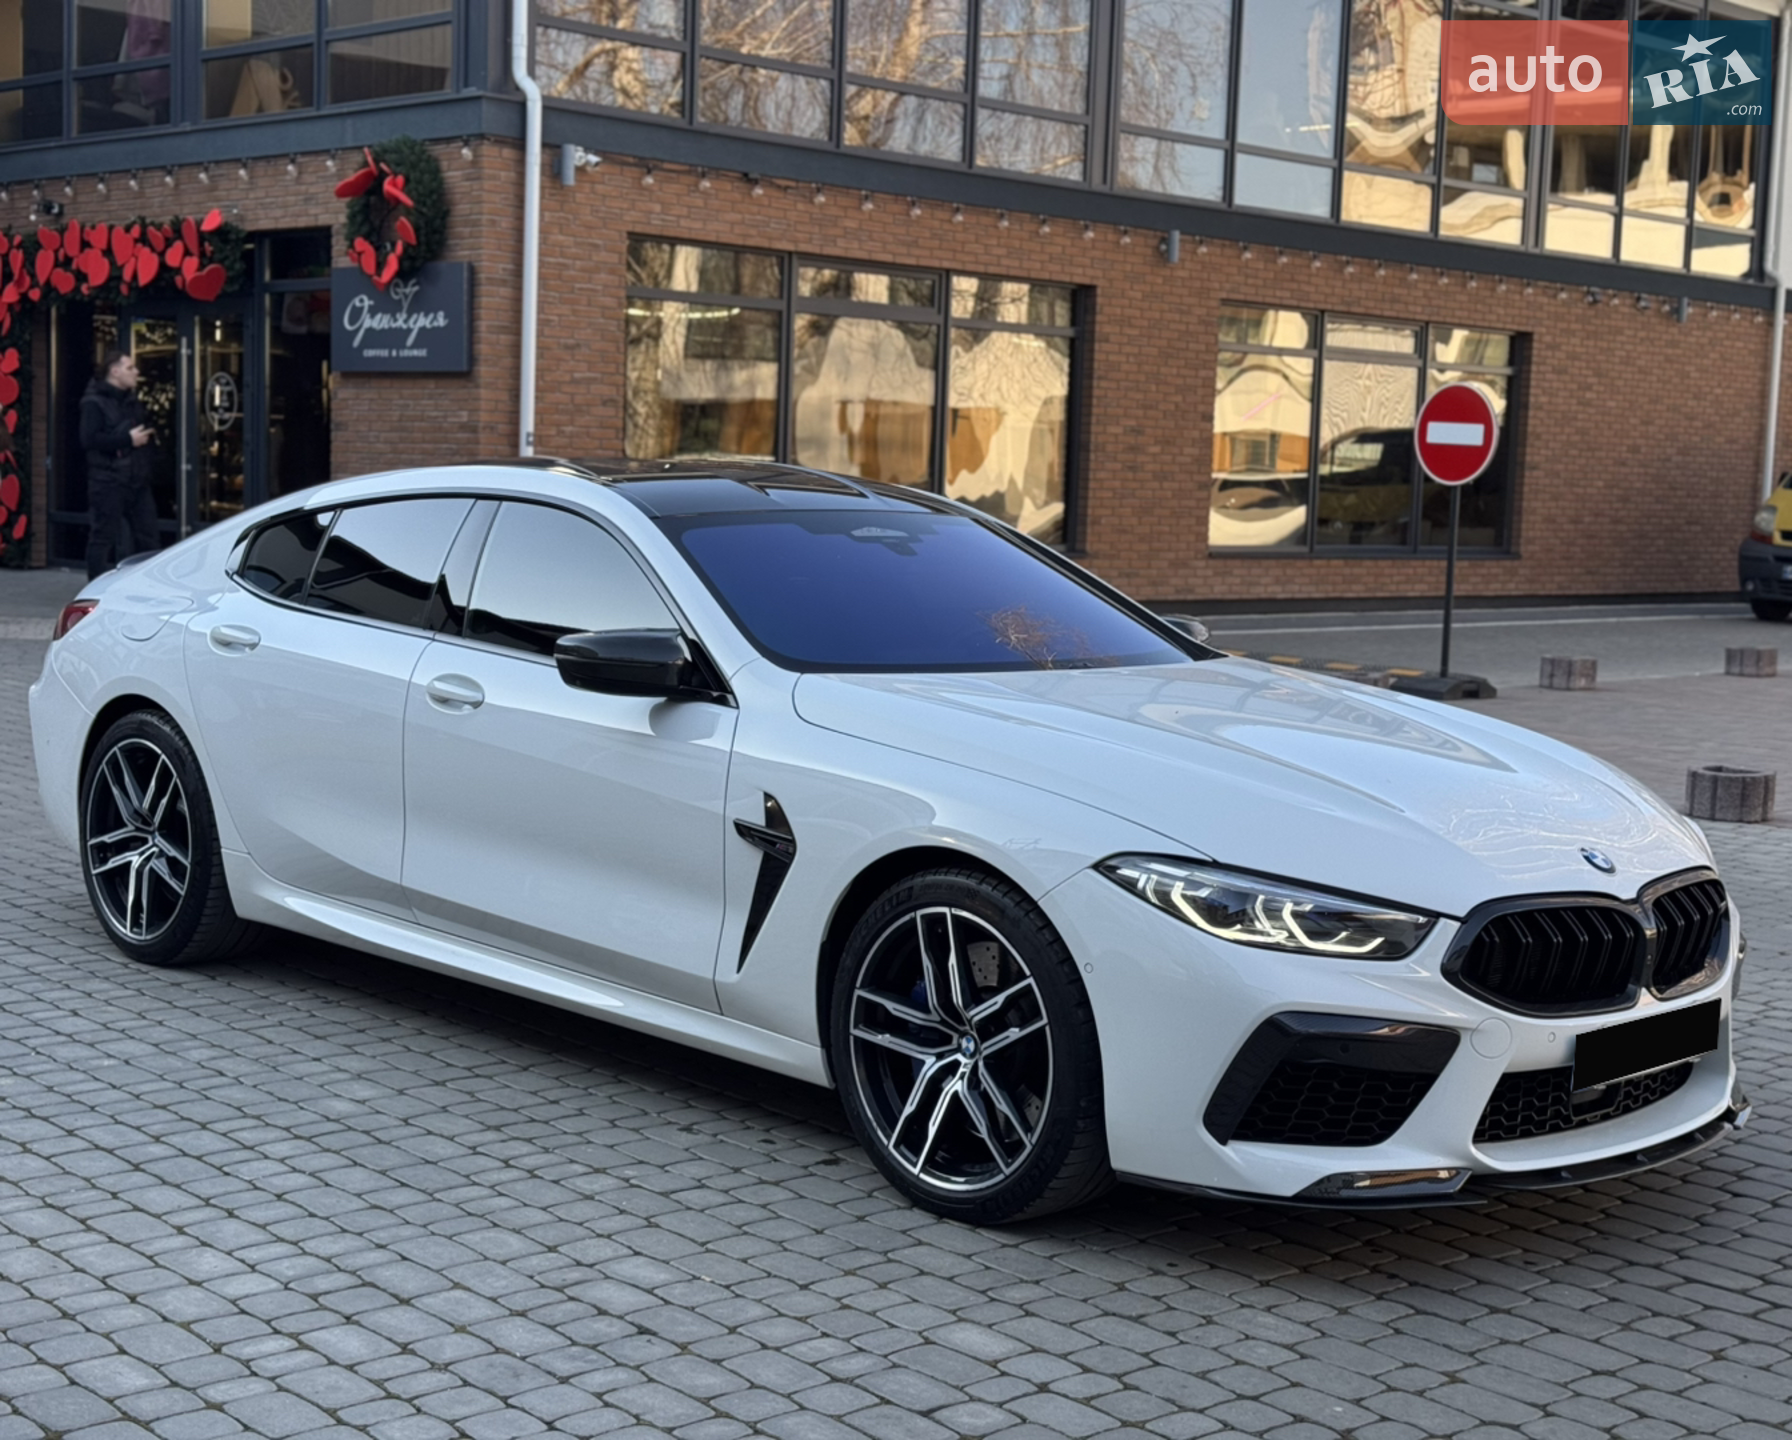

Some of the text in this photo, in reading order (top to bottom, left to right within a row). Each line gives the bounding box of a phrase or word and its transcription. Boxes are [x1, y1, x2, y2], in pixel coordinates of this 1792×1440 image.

[343, 294, 448, 348] Оранжерея
[363, 349, 389, 358] COFFEE
[399, 349, 427, 358] LOUNGE
